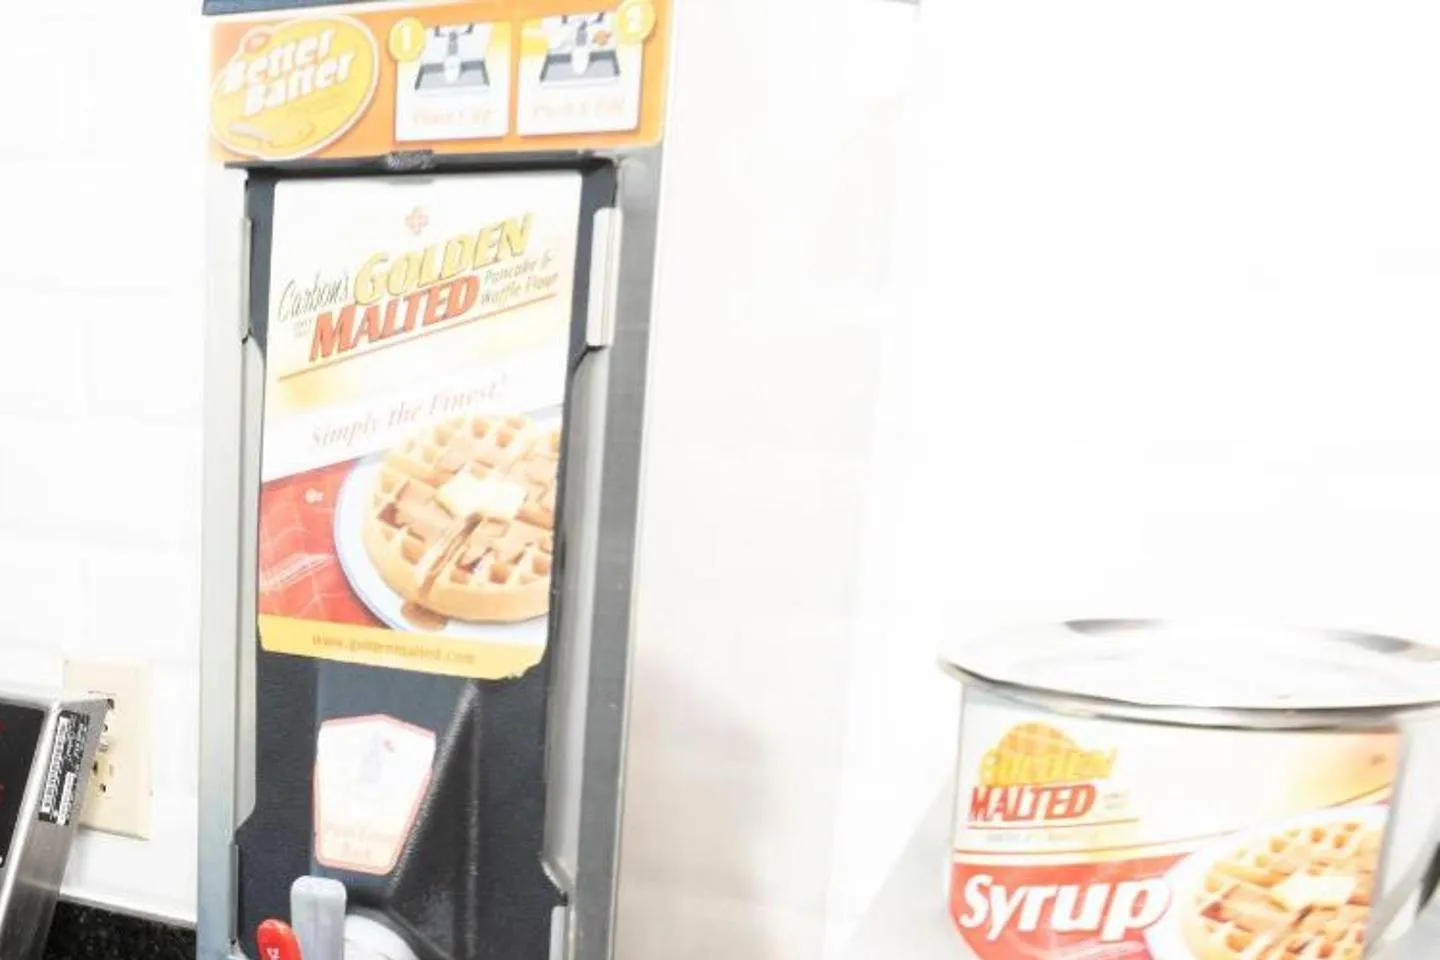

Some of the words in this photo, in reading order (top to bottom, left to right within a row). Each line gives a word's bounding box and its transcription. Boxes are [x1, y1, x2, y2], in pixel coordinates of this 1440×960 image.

[353, 211, 536, 307] GOLDEN
[308, 273, 481, 363] MALTED
[968, 783, 1098, 822] MALTED
[962, 873, 1172, 942] Syrup
